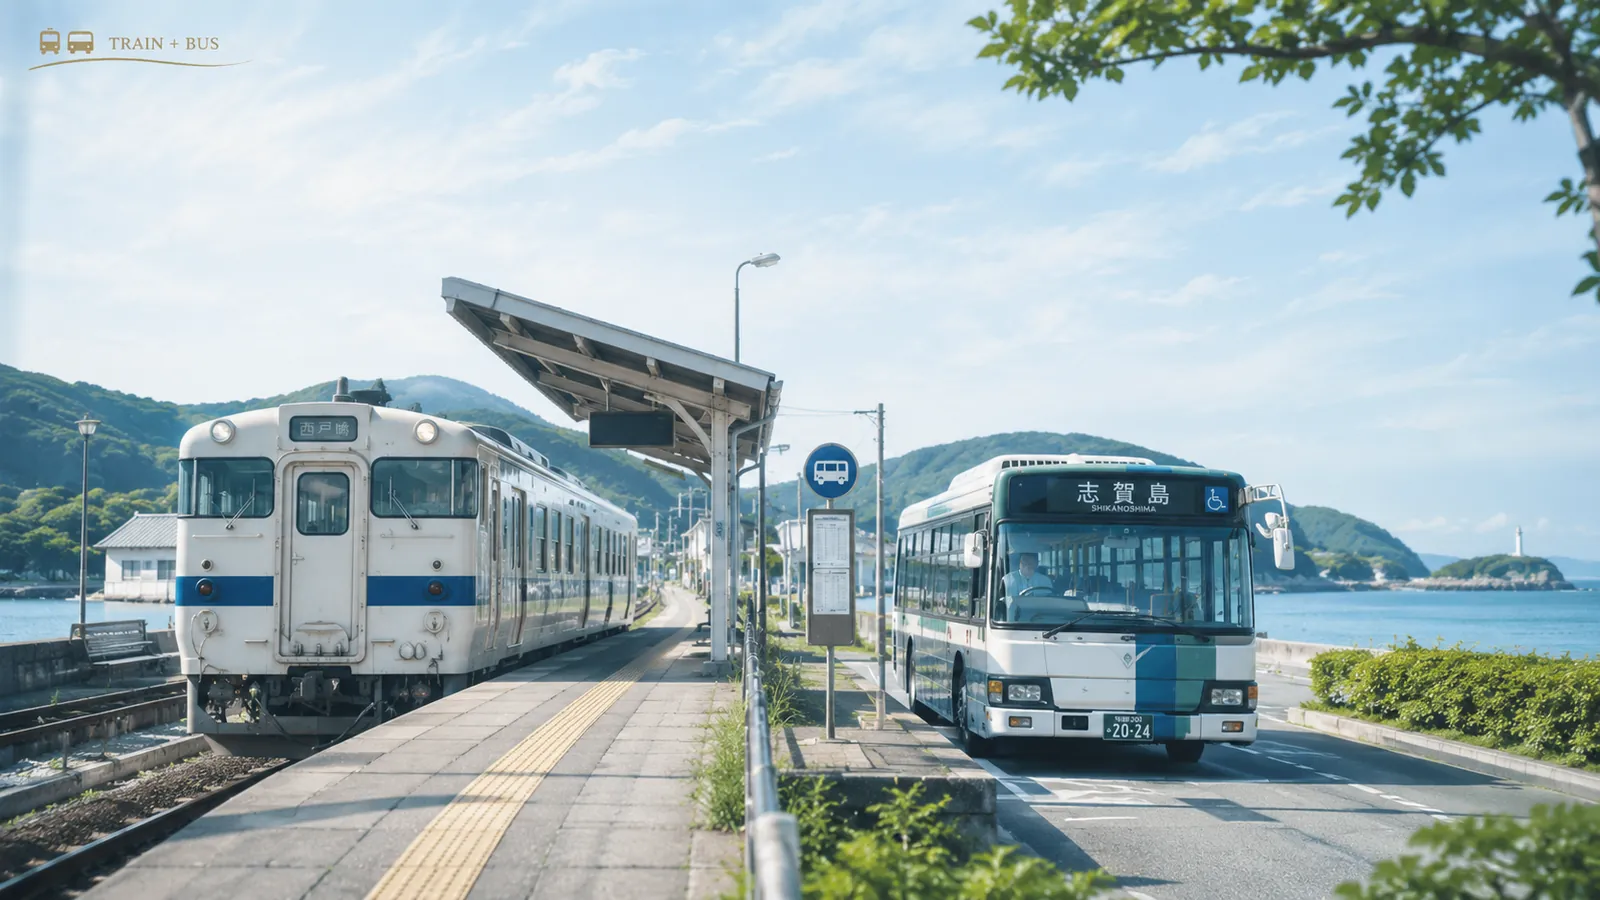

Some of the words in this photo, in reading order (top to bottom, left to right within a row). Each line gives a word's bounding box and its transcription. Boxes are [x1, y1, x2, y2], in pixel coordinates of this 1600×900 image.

[1077, 481, 1170, 505] 志賀島
[1091, 505, 1157, 513] SHIKANOSHIMA
